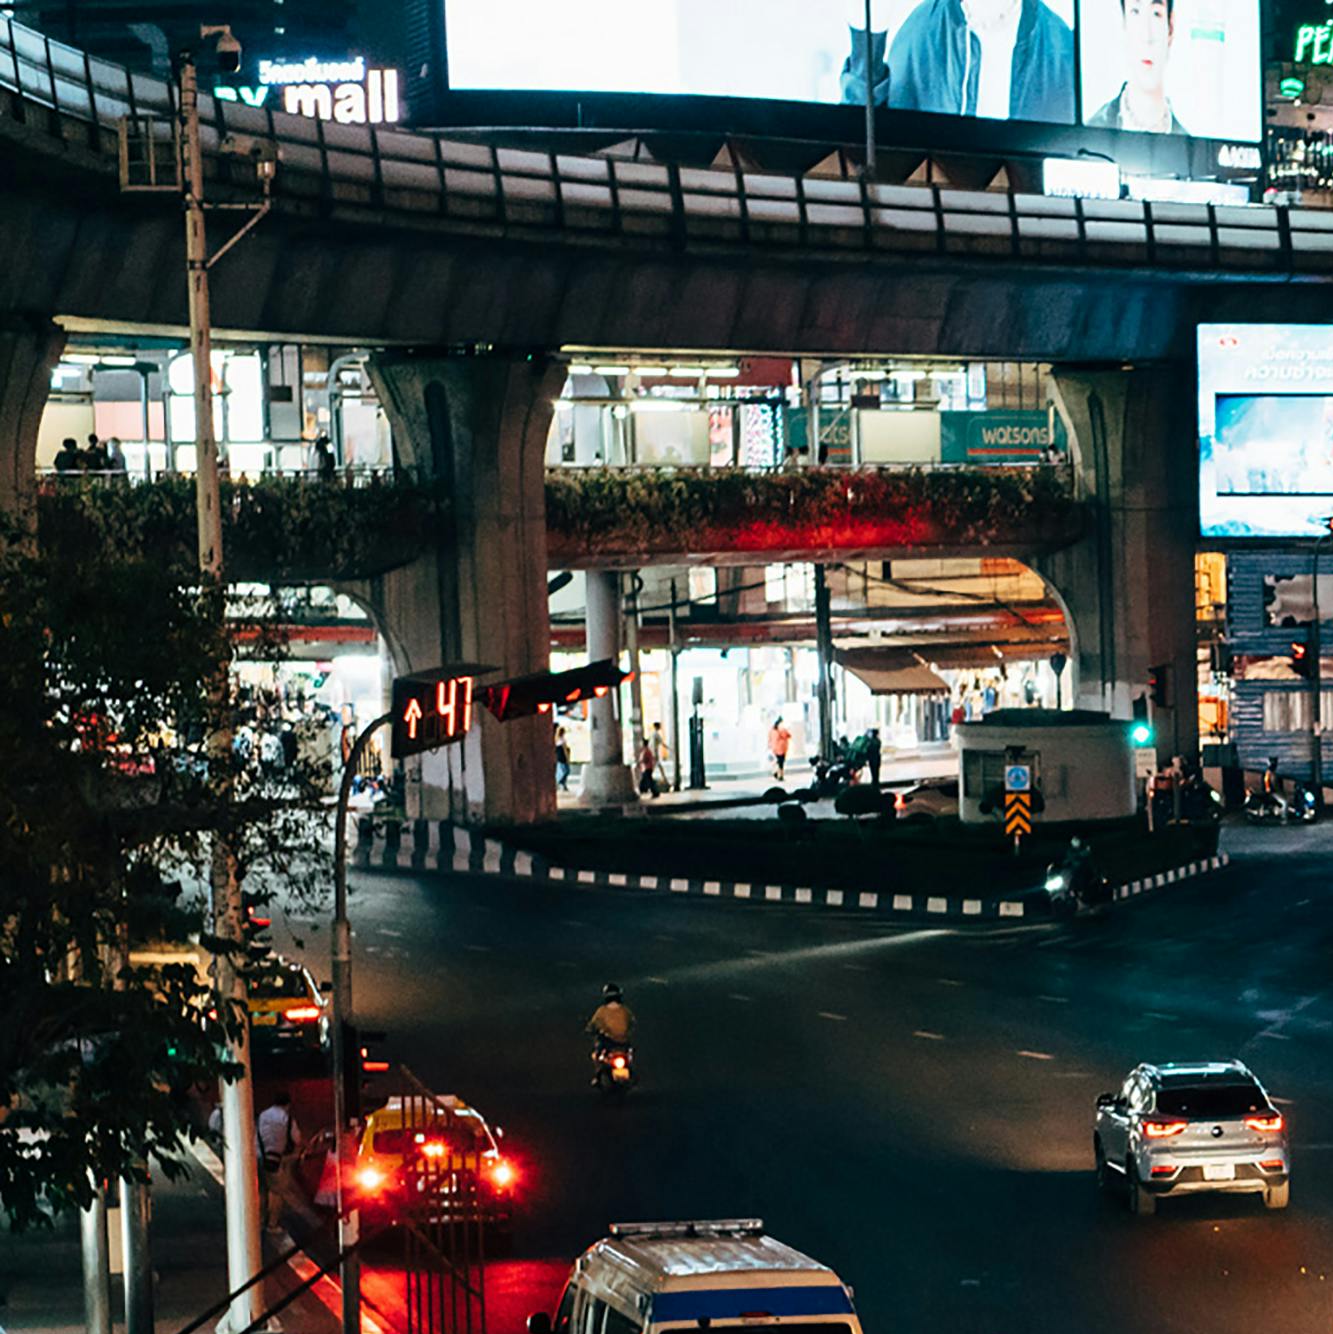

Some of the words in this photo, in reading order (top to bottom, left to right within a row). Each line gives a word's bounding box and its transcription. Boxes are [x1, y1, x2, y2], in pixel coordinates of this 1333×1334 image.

[285, 69, 399, 124] mall
[982, 424, 1048, 445] watsons
[436, 676, 474, 736] 47
